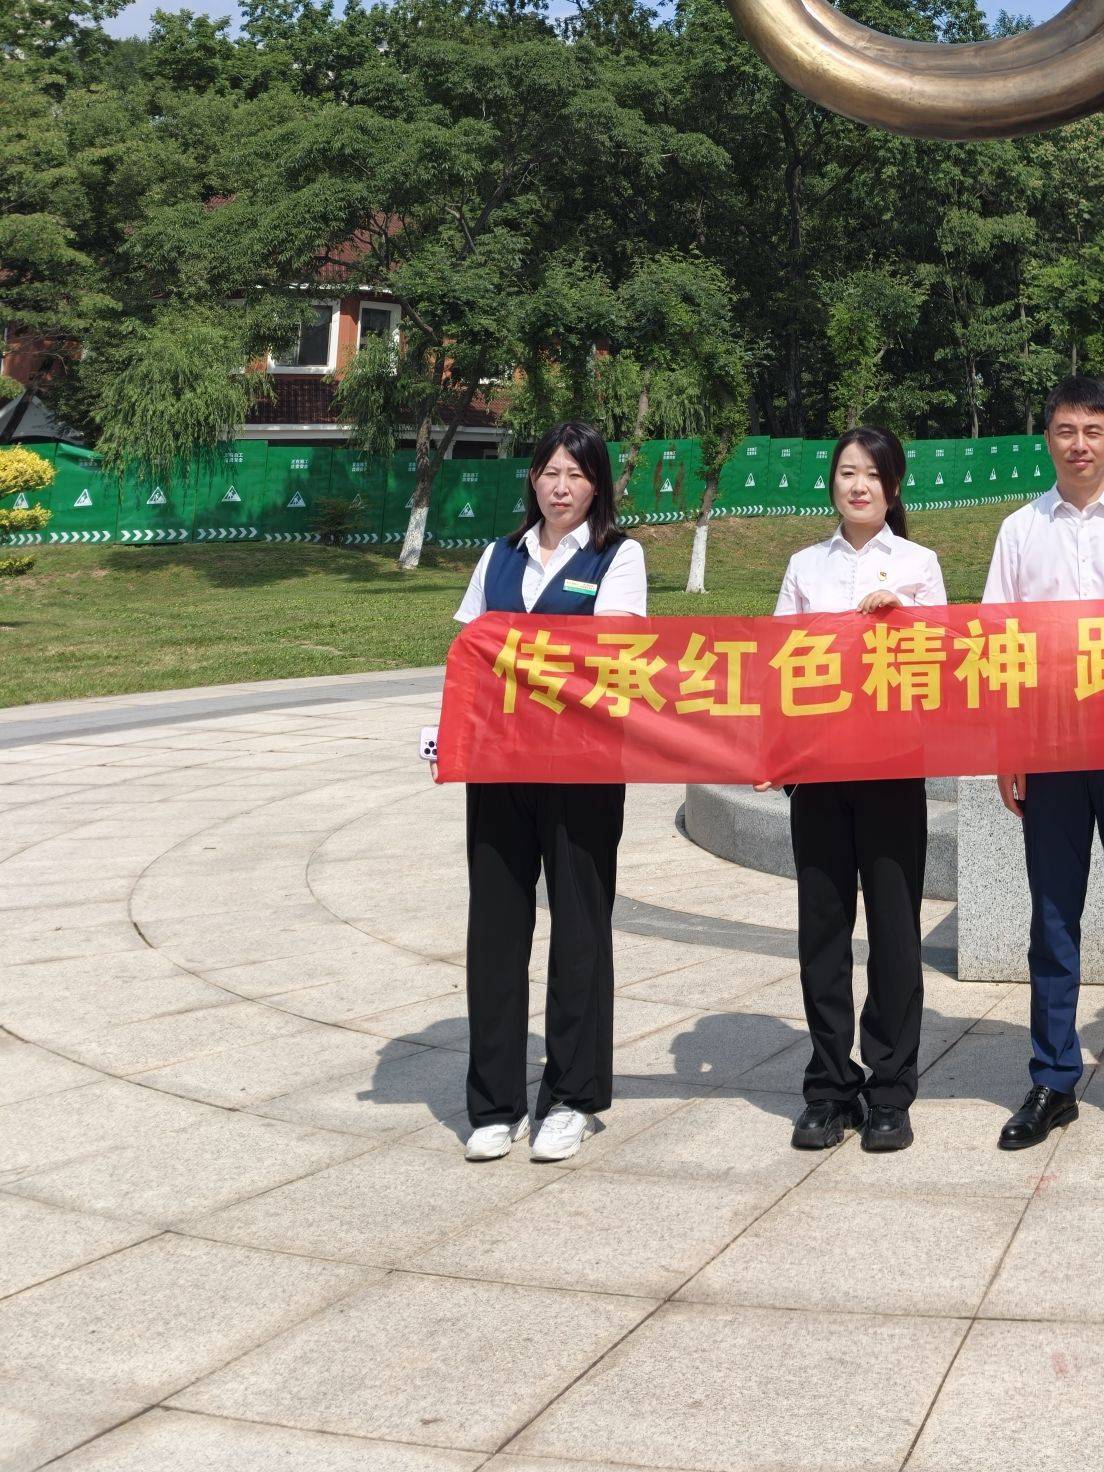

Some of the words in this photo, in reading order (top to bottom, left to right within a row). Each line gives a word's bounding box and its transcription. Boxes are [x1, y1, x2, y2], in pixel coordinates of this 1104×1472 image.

[493, 617, 1038, 718] 传承红色精神
